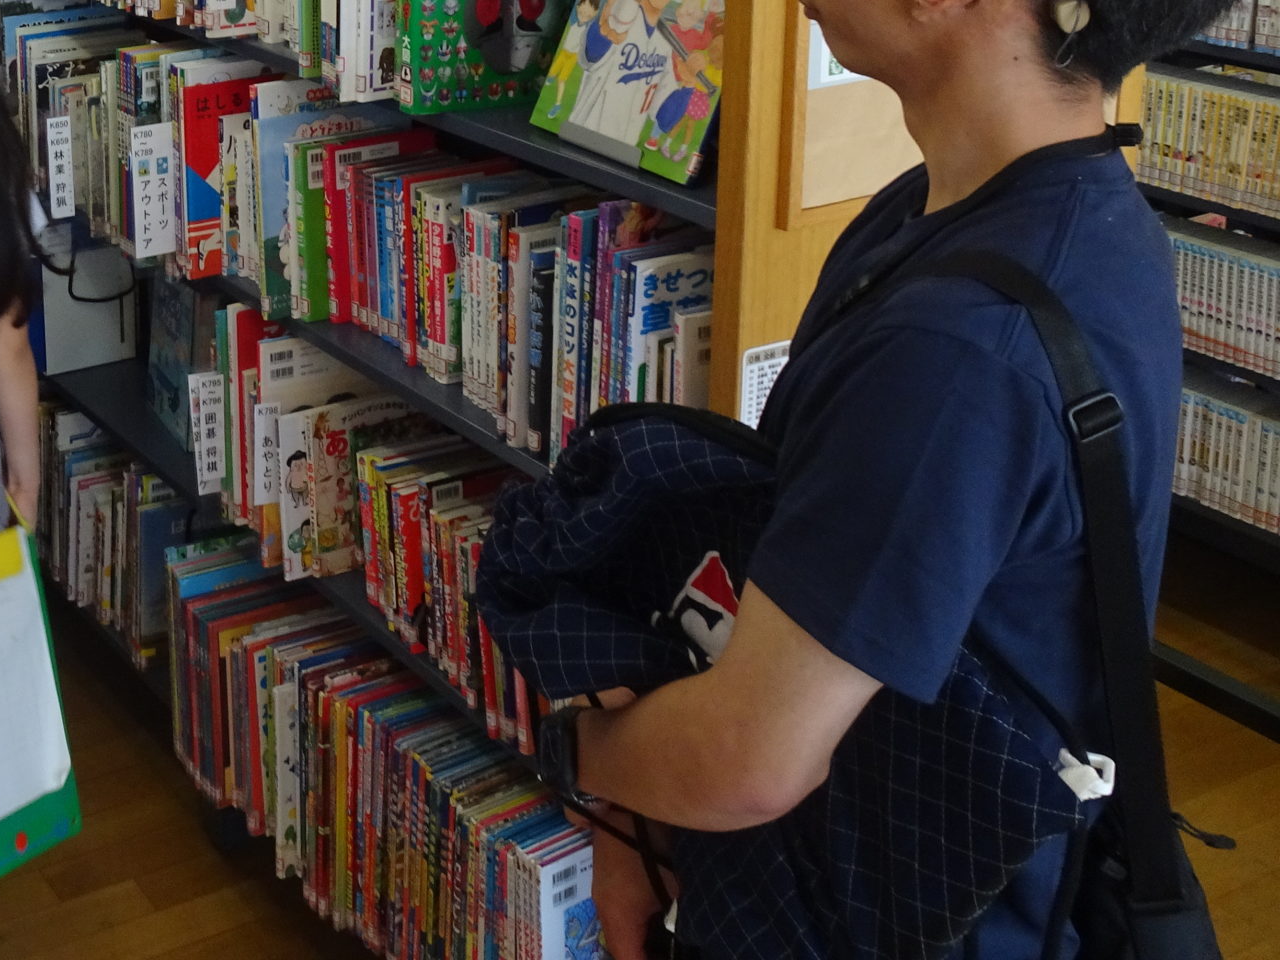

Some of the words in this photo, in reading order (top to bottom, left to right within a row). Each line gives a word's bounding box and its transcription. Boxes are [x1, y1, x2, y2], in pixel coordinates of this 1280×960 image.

[49, 119, 69, 129] K650
[133, 129, 153, 139] K780
[50, 138, 69, 147] K659
[134, 147, 153, 157] K789
[53, 150, 65, 175] 林業
[55, 182, 68, 208] 狩猟
[157, 178, 169, 231] スポーツ
[140, 179, 153, 250] アウトドア
[643, 268, 713, 300] きせつ
[258, 406, 279, 416] K798
[204, 412, 217, 439] 囲碁
[206, 446, 218, 473] 将棋
[262, 435, 274, 494] あやとり
